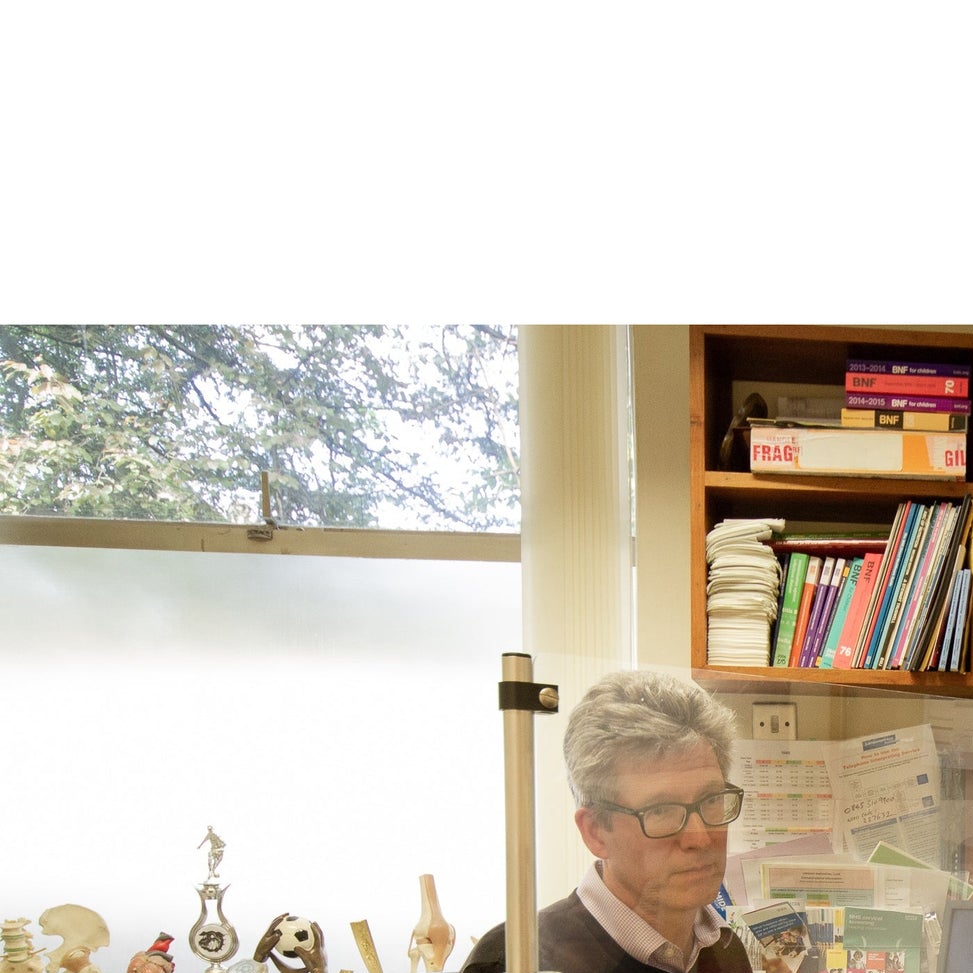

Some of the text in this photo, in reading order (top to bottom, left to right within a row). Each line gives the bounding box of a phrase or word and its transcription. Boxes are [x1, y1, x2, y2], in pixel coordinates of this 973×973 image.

[892, 365, 908, 374] BNF
[852, 377, 876, 388] BNF
[945, 380, 954, 394] 70
[849, 397, 886, 407] 2014-2015
[891, 399, 907, 408] BNF
[879, 415, 899, 424] BNF
[850, 565, 862, 585] BNF
[864, 561, 874, 584] BNF
[840, 646, 851, 656] 76
[842, 761, 869, 770] Telephone
